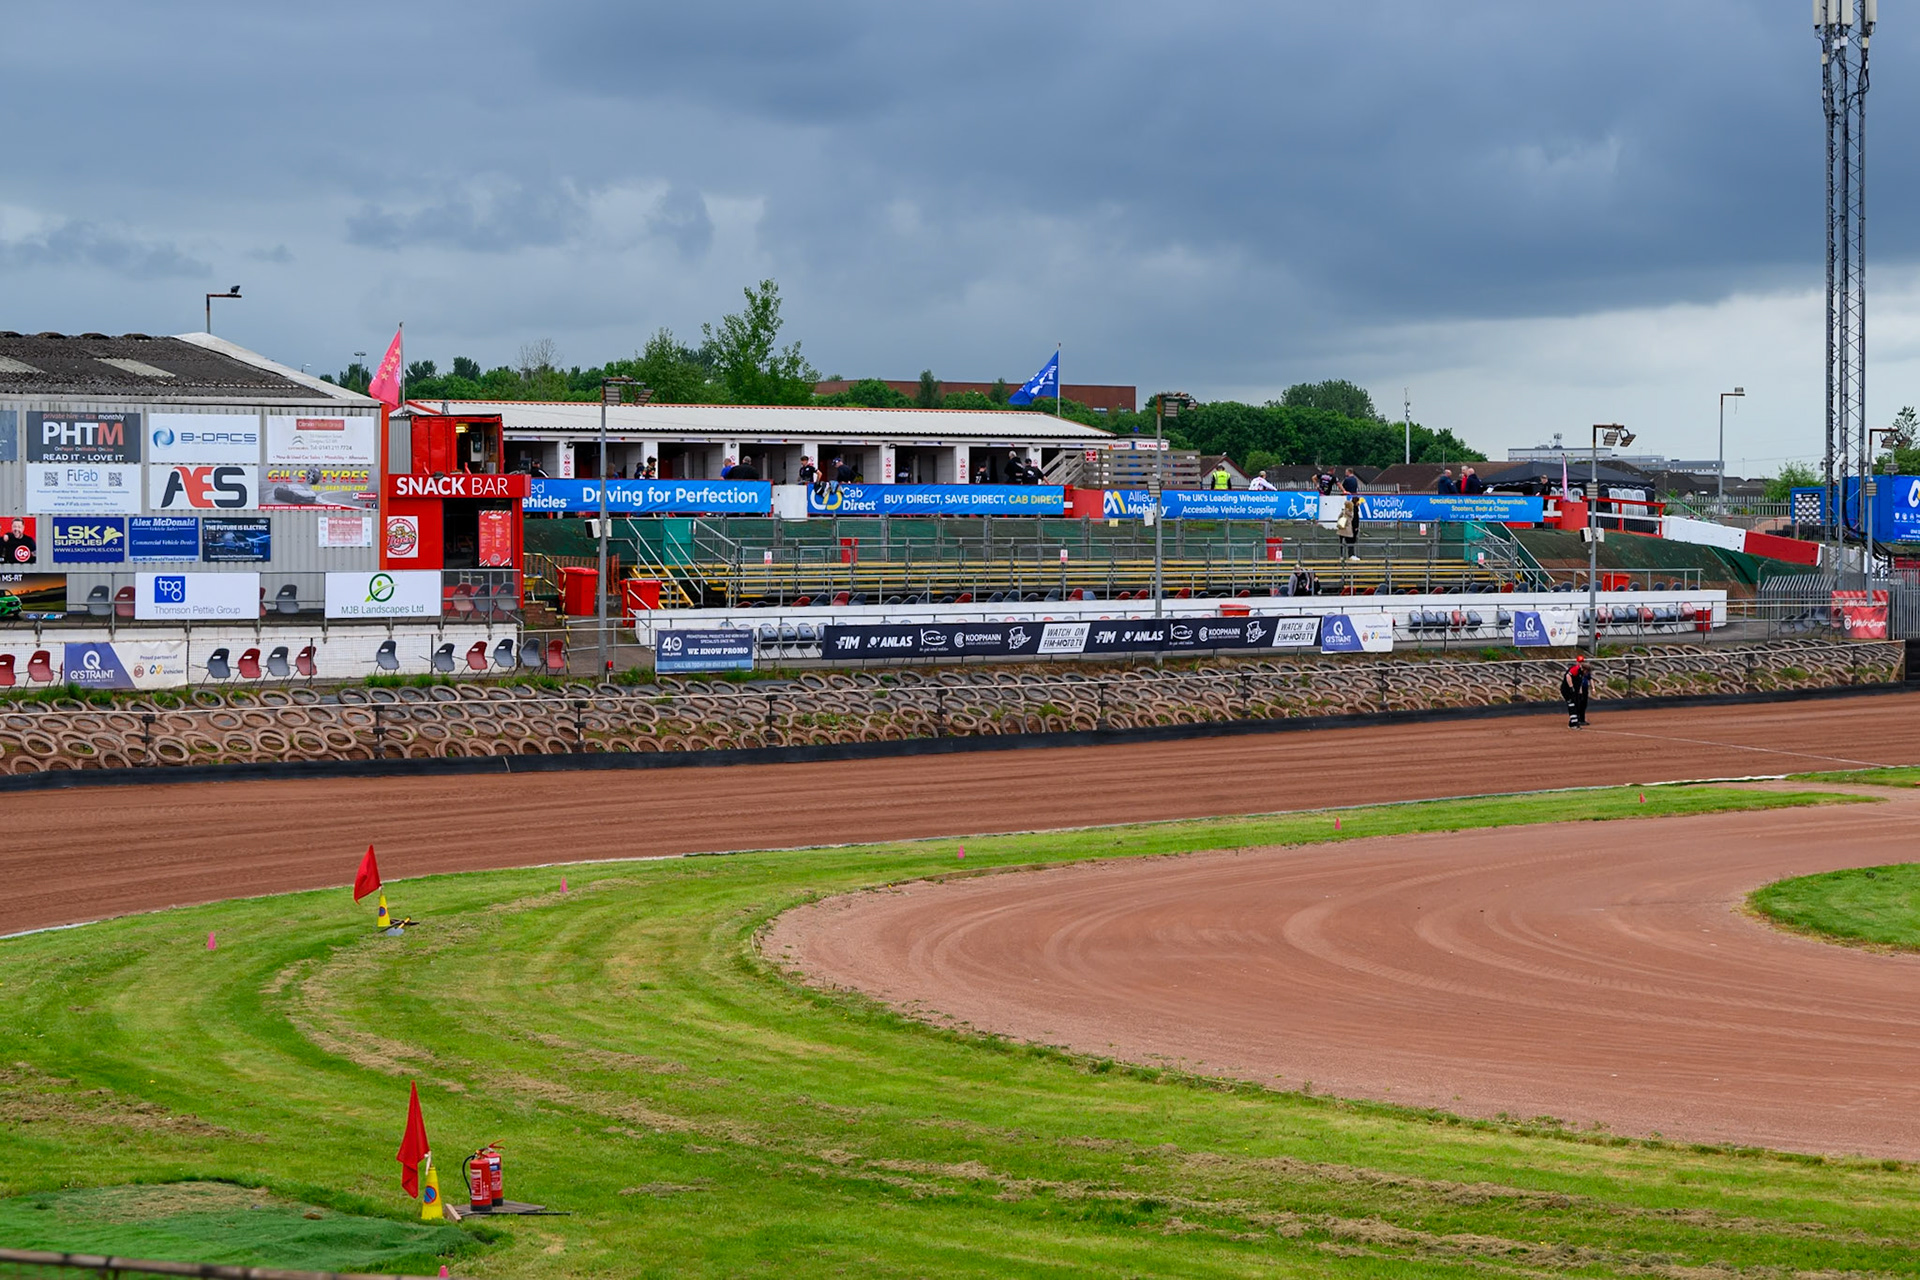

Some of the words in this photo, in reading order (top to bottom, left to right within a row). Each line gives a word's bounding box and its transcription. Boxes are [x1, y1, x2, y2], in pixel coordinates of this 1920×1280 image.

[98, 413, 125, 422] monthly
[43, 422, 124, 446] PHTM
[181, 432, 257, 443] B-DACS
[67, 469, 98, 482] FiFab
[268, 470, 307, 483] GIL'S
[320, 470, 369, 483] TYRES
[161, 466, 247, 508] AES
[396, 477, 466, 496] SNACK
[471, 477, 509, 496] BAR
[522, 494, 567, 508] ehicles
[583, 486, 642, 507] Drving
[648, 487, 671, 503] for
[676, 487, 758, 504] Perfection
[843, 487, 863, 498] Cab
[884, 494, 904, 504] BUY
[906, 495, 942, 505] DIRECT,
[945, 494, 969, 504] SAVE
[971, 495, 1007, 505] DIRECT,
[1008, 495, 1028, 504] CAB
[1030, 495, 1063, 504] DIRECT
[1177, 494, 1191, 502] The
[1192, 494, 1208, 502] UK's
[1209, 494, 1238, 504] Leading
[1239, 494, 1279, 502] Wheelchair
[842, 499, 876, 511] Direct
[1373, 497, 1404, 509] Mobility
[1182, 506, 1219, 514] Accessible
[1220, 506, 1246, 514] Vehicle
[1247, 506, 1277, 515] Supplier
[1373, 508, 1413, 519] Solutions
[132, 518, 151, 527] Alex
[153, 518, 195, 526] McDonald
[54, 526, 101, 539] LSK
[17, 549, 29, 557] Go
[158, 577, 182, 602] tpg
[155, 606, 190, 615] Thomson
[192, 606, 215, 615] Pettie
[216, 606, 241, 615] Group
[341, 606, 359, 615] MJB
[361, 605, 409, 615] Landscapes
[411, 604, 424, 613] Ltd
[1047, 628, 1071, 636] WATCH
[1074, 627, 1086, 635] ON
[1280, 622, 1303, 630] WATCH
[1306, 622, 1316, 630] ON
[836, 636, 861, 650] FIM
[880, 635, 914, 648] ANLAS
[965, 633, 1002, 642] KOOPMANN
[1095, 631, 1117, 644] FIM
[1134, 630, 1164, 641] ANLAS
[1208, 628, 1241, 636] KOOPMANN
[662, 636, 682, 652] 40
[1044, 638, 1084, 647] FIM-MOTO.TV
[70, 670, 115, 680] Q'STRAINT
